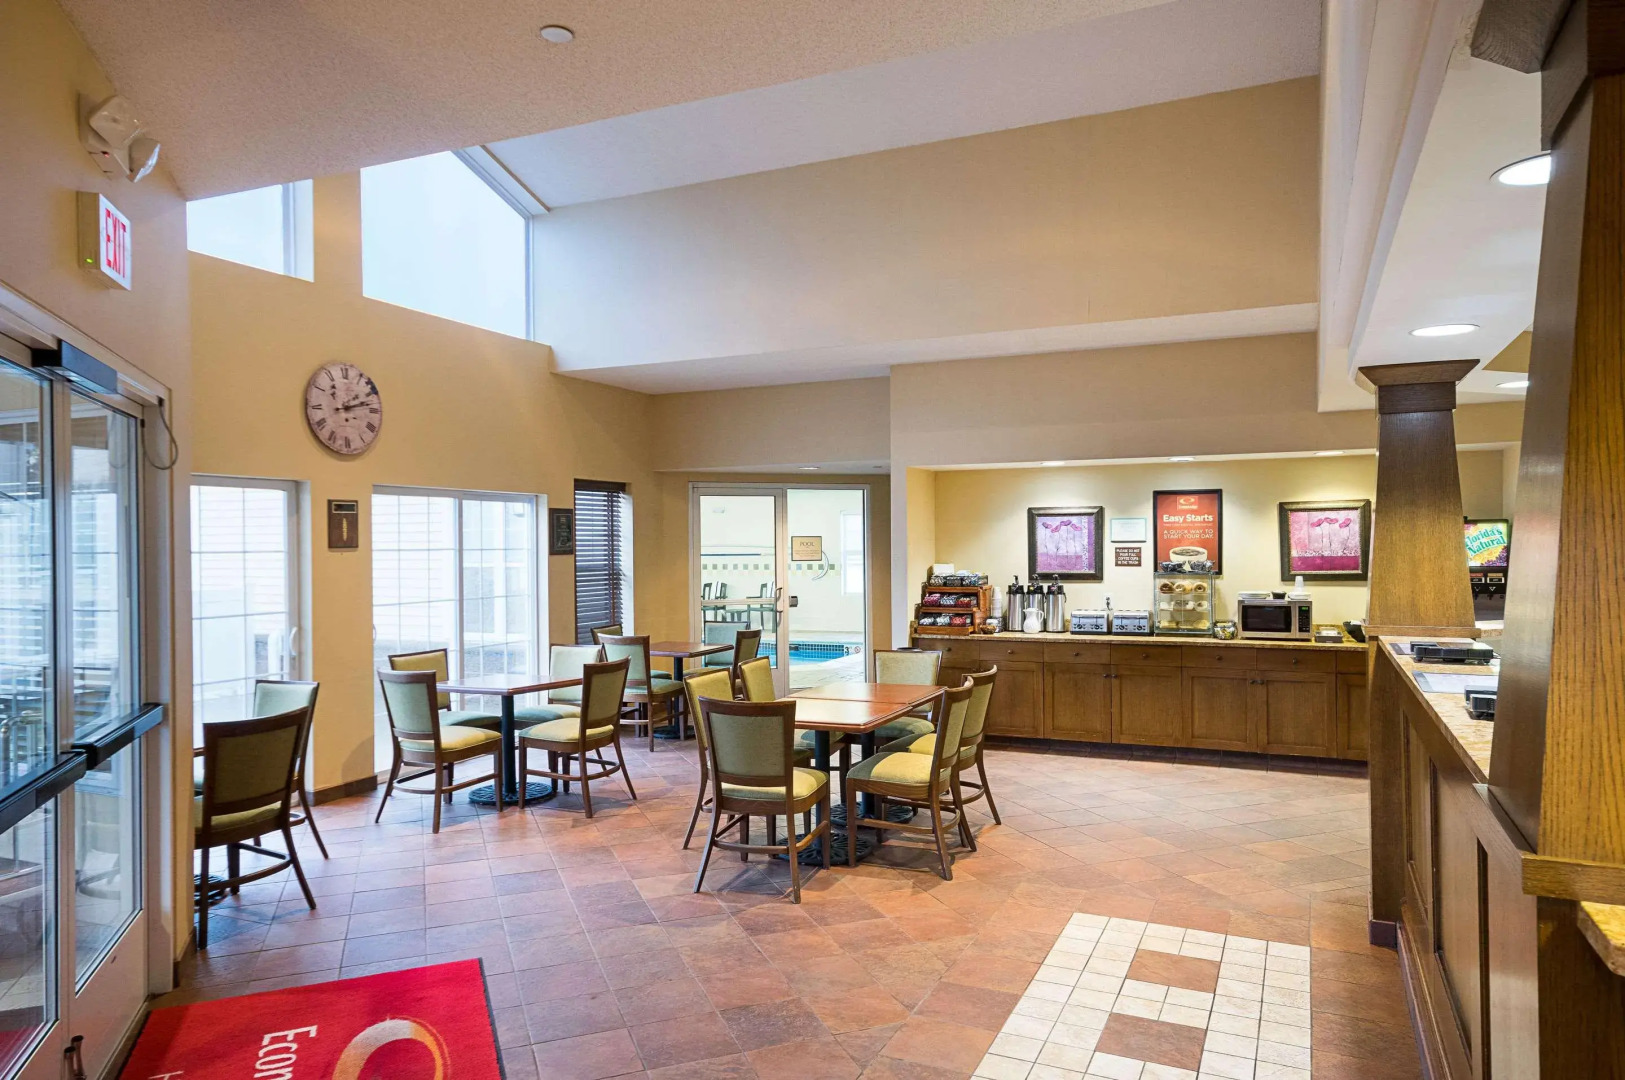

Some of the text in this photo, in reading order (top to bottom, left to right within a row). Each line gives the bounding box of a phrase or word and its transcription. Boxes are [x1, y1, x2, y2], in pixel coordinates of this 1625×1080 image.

[105, 207, 127, 279] EXIT
[1163, 513, 1213, 523] Easy Starts
[1465, 527, 1503, 548] lorida's
[1467, 535, 1506, 556] Natural
